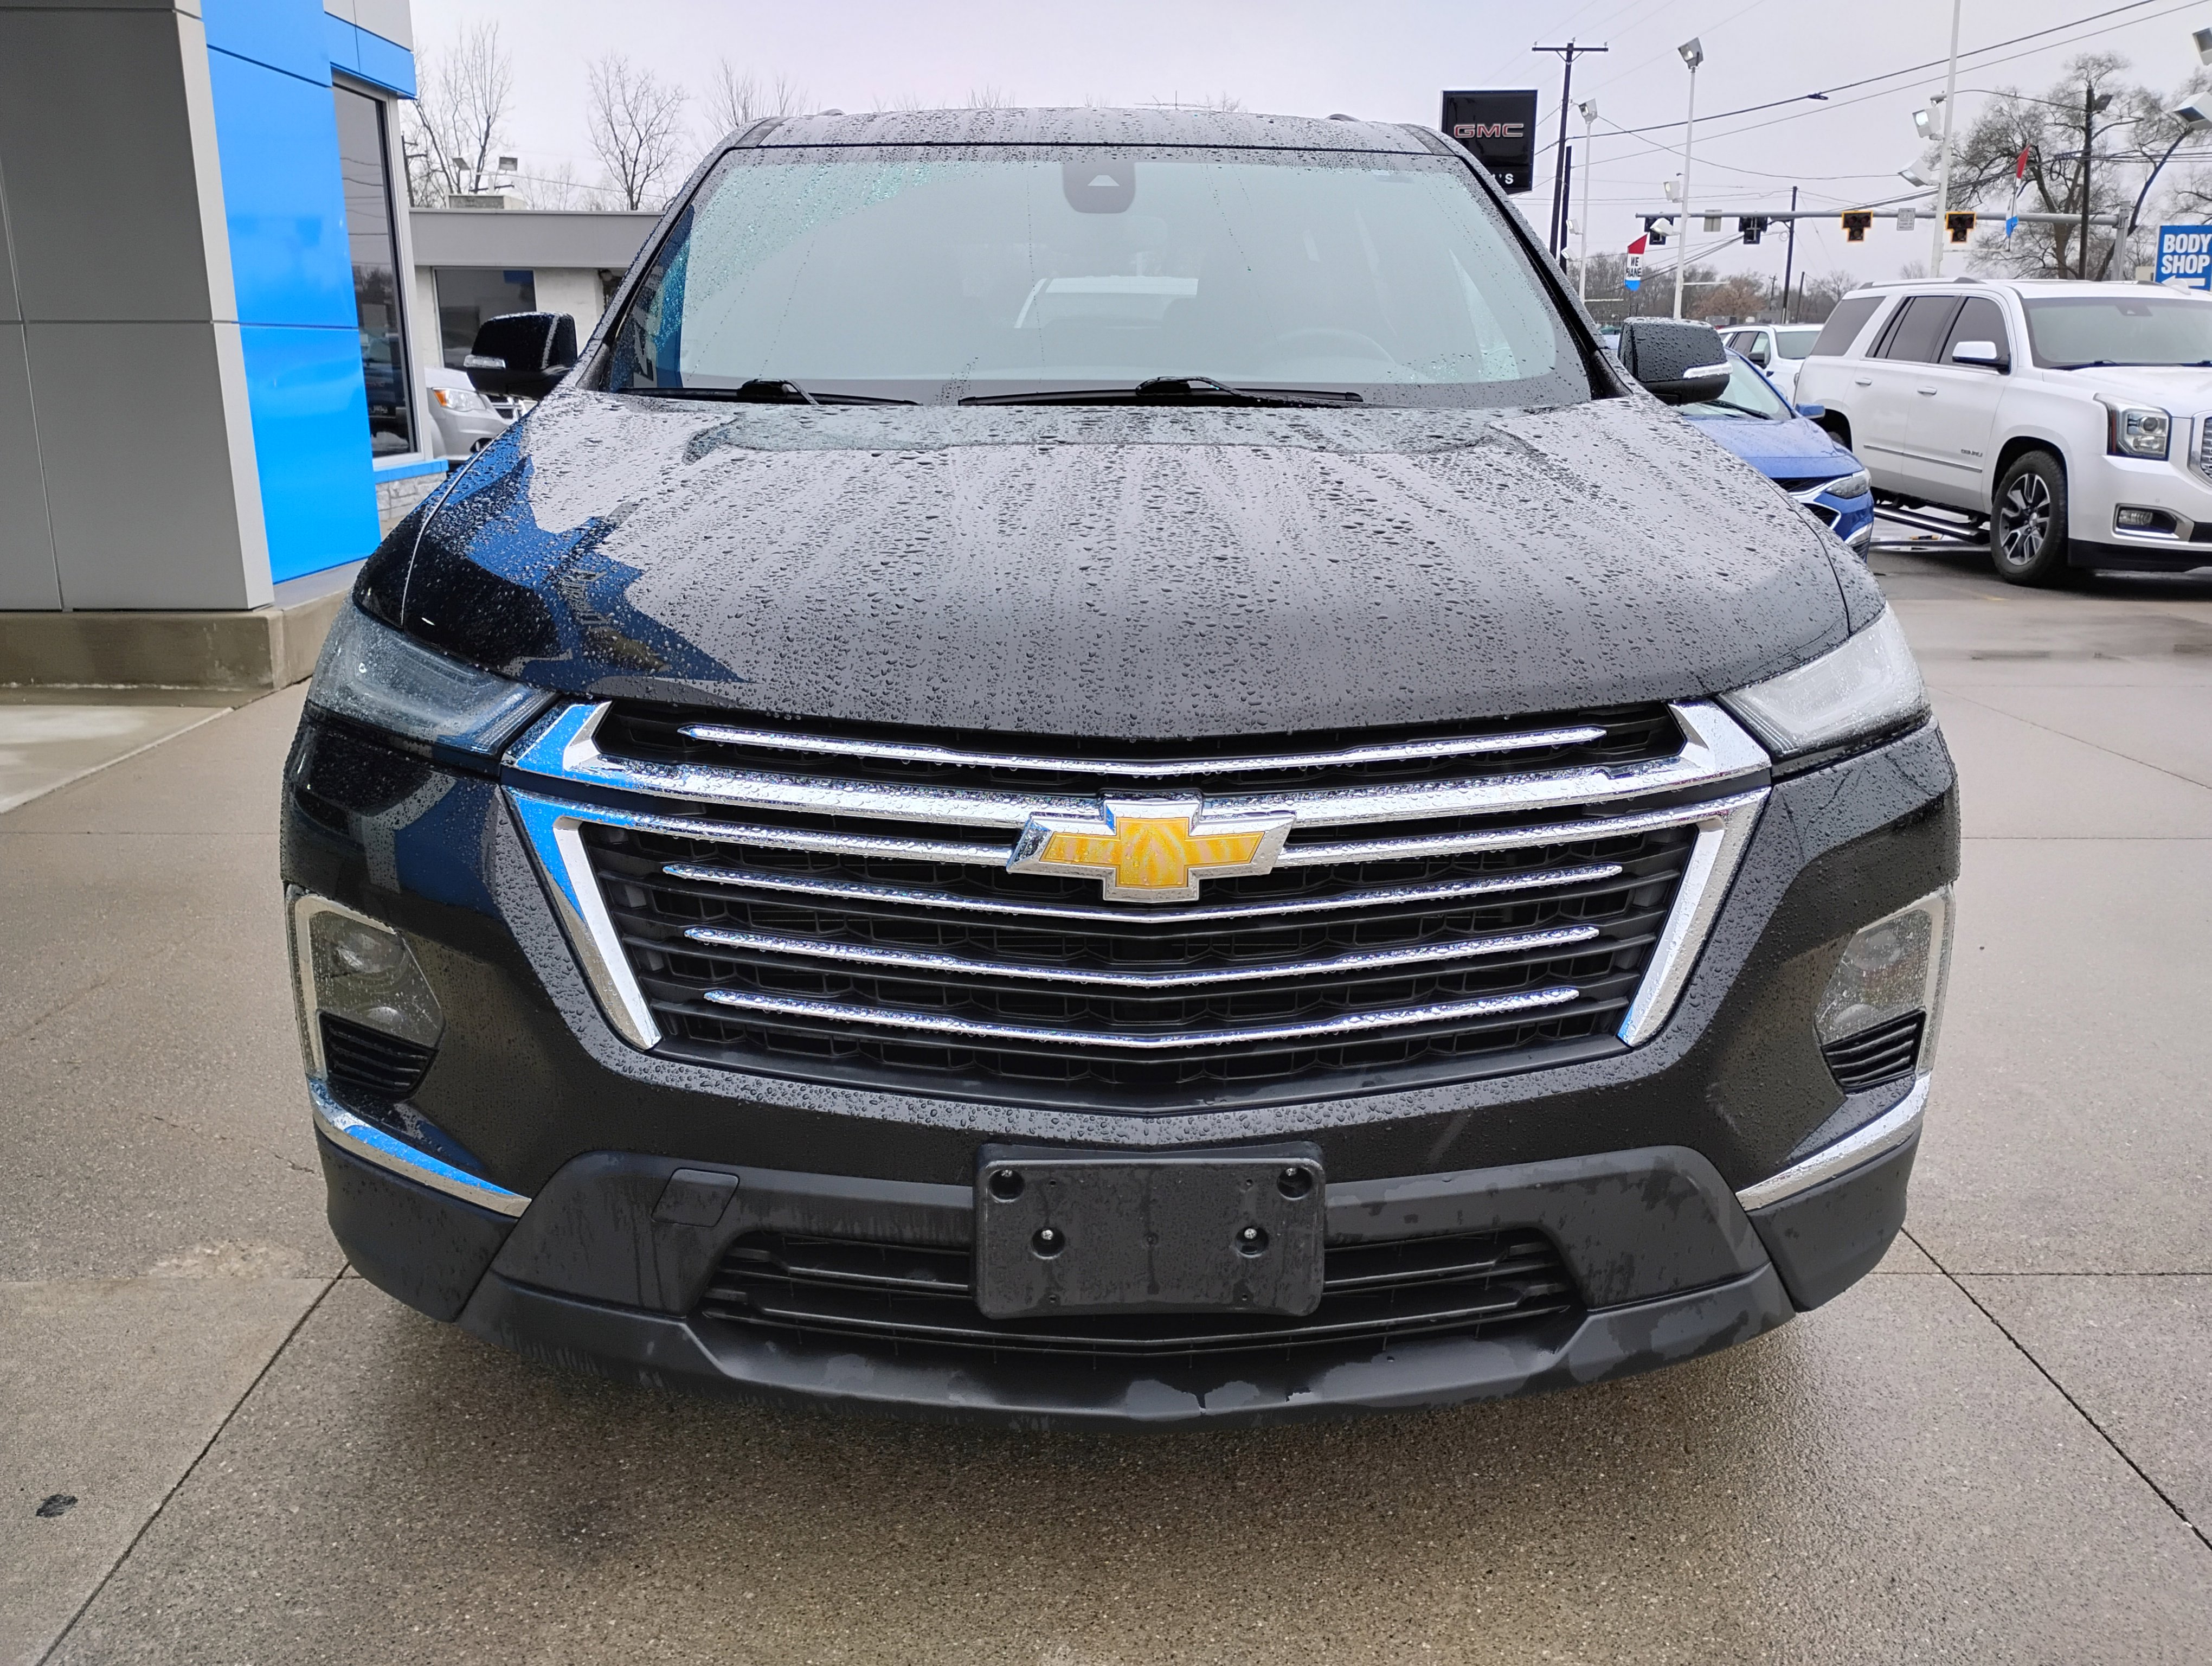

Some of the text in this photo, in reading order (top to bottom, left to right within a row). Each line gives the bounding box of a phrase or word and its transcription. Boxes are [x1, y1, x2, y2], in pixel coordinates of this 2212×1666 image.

[1454, 123, 1524, 138] GMC
[2163, 233, 2212, 253] BODY
[1631, 256, 1639, 266] WE
[2161, 254, 2210, 274] SHOP
